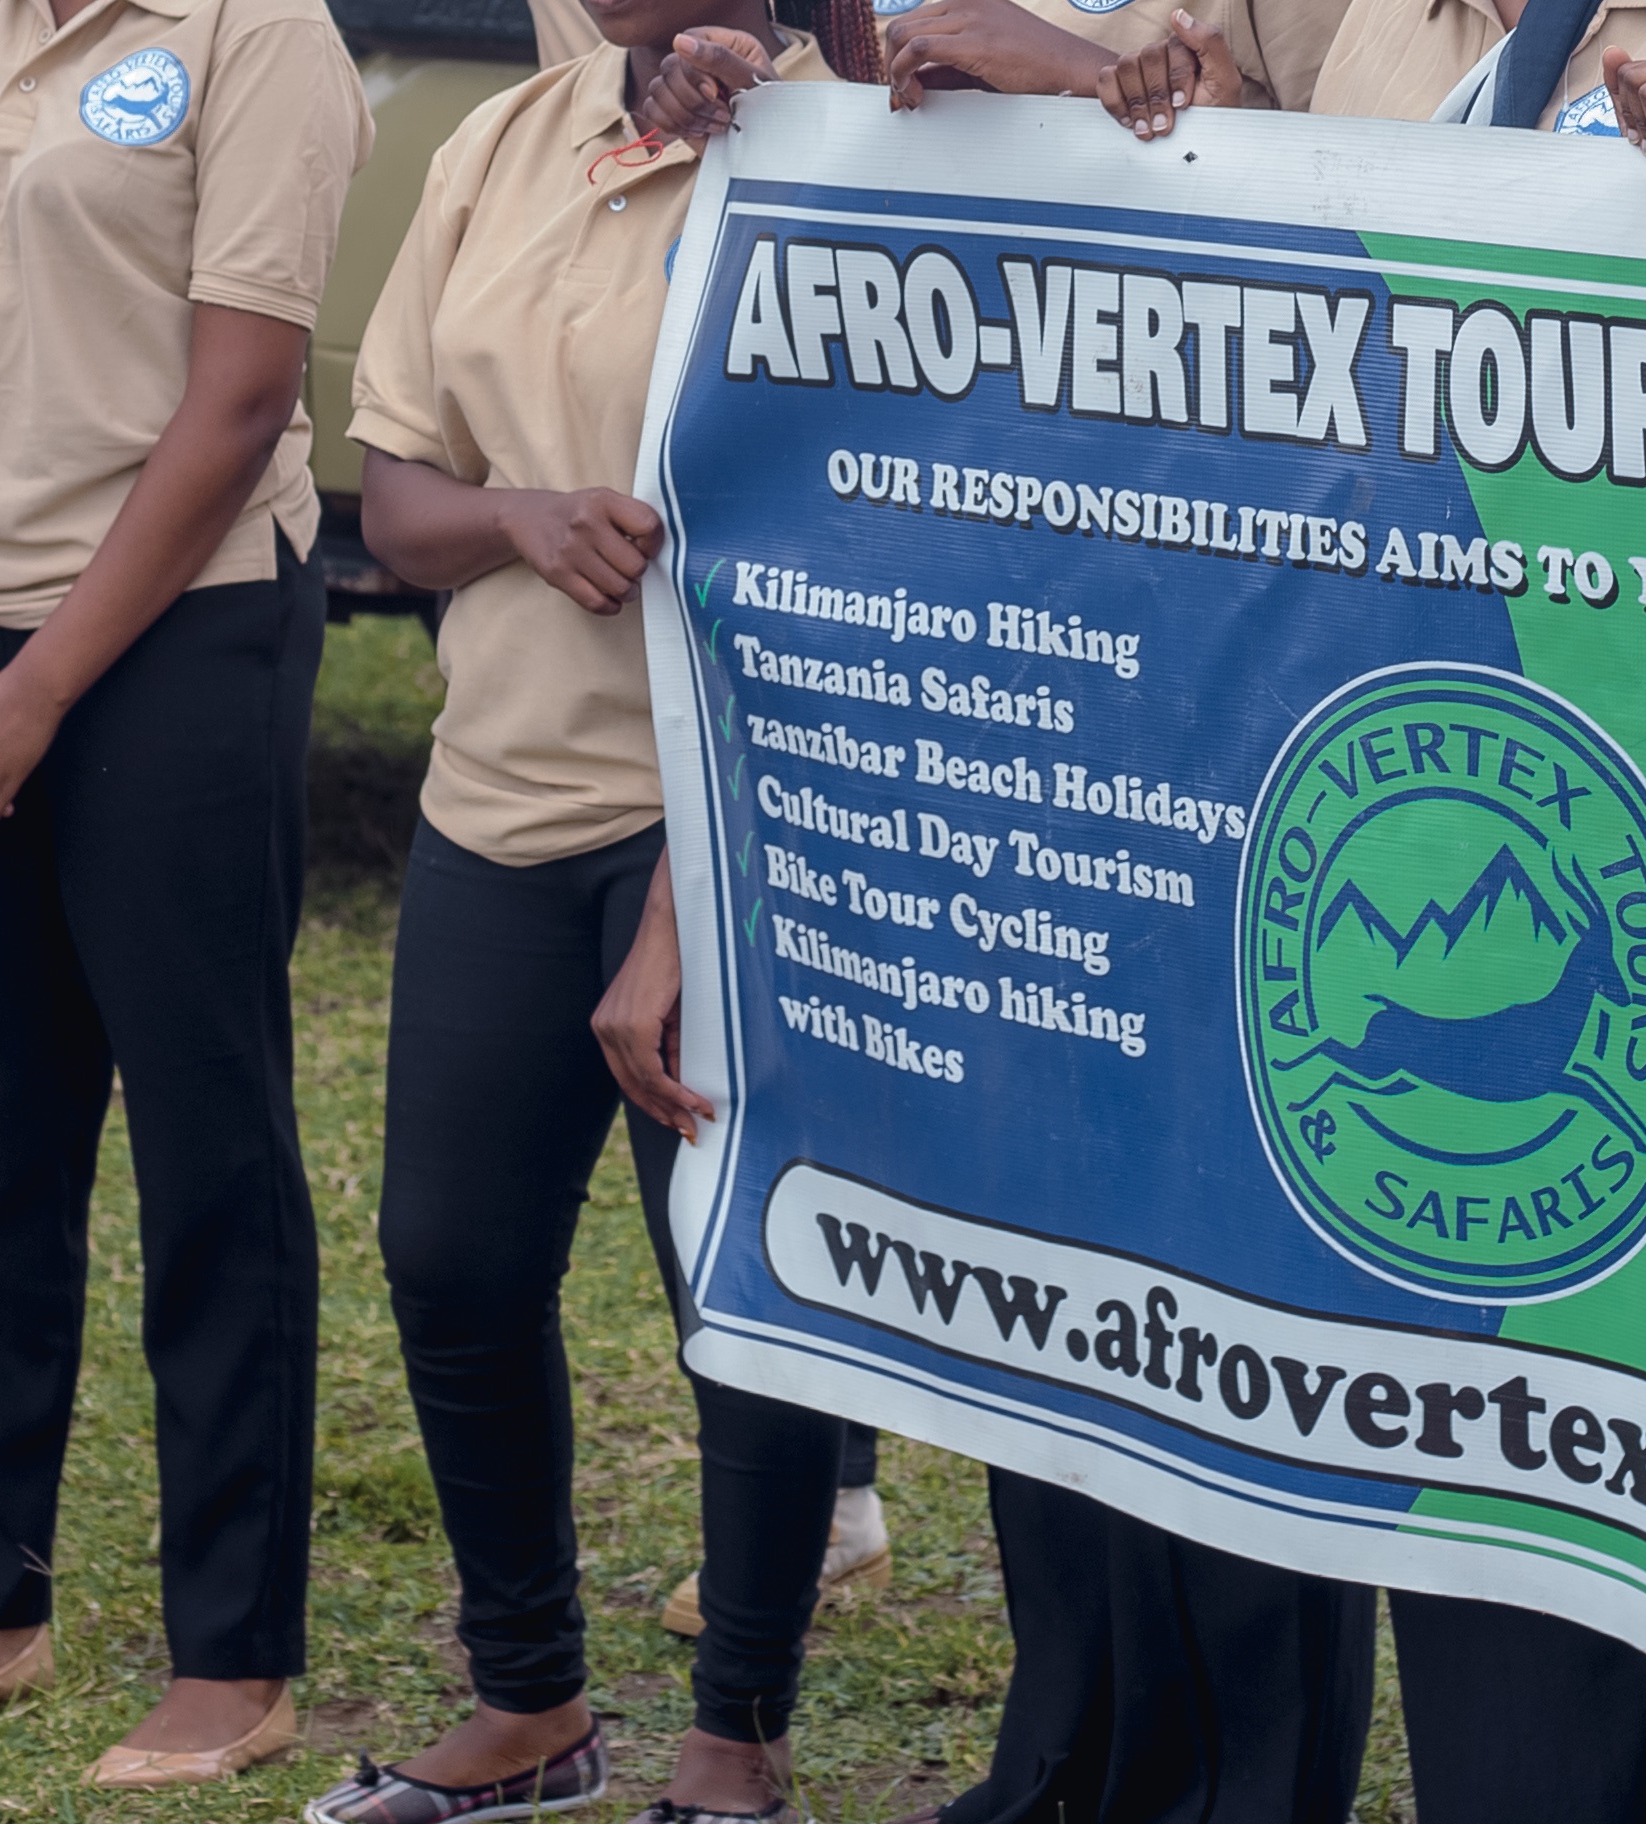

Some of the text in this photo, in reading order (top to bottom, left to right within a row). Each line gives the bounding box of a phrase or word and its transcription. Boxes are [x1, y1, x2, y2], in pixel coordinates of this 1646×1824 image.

[725, 233, 1372, 450] AFRO-VERTEX
[827, 448, 922, 507] OUR
[928, 462, 1367, 572] RESPONSIBILITIES
[1375, 527, 1525, 598] AIMS
[1537, 546, 1617, 604] TO
[732, 560, 1141, 681] Kilimanjaro Hiking
[733, 633, 1076, 735] Tanzania Safaris
[746, 713, 1248, 844] zanzibar Beach Holidays
[757, 774, 1196, 909] Cultural Day Tourism
[763, 843, 1111, 976] Bike Tour Cycling
[1261, 722, 1593, 1038] AFRO-VERTEX
[771, 913, 1148, 1059] Kilimanjaro hiking
[778, 994, 966, 1085] with Bikes
[1298, 1107, 1637, 1245] & SAFARIS
